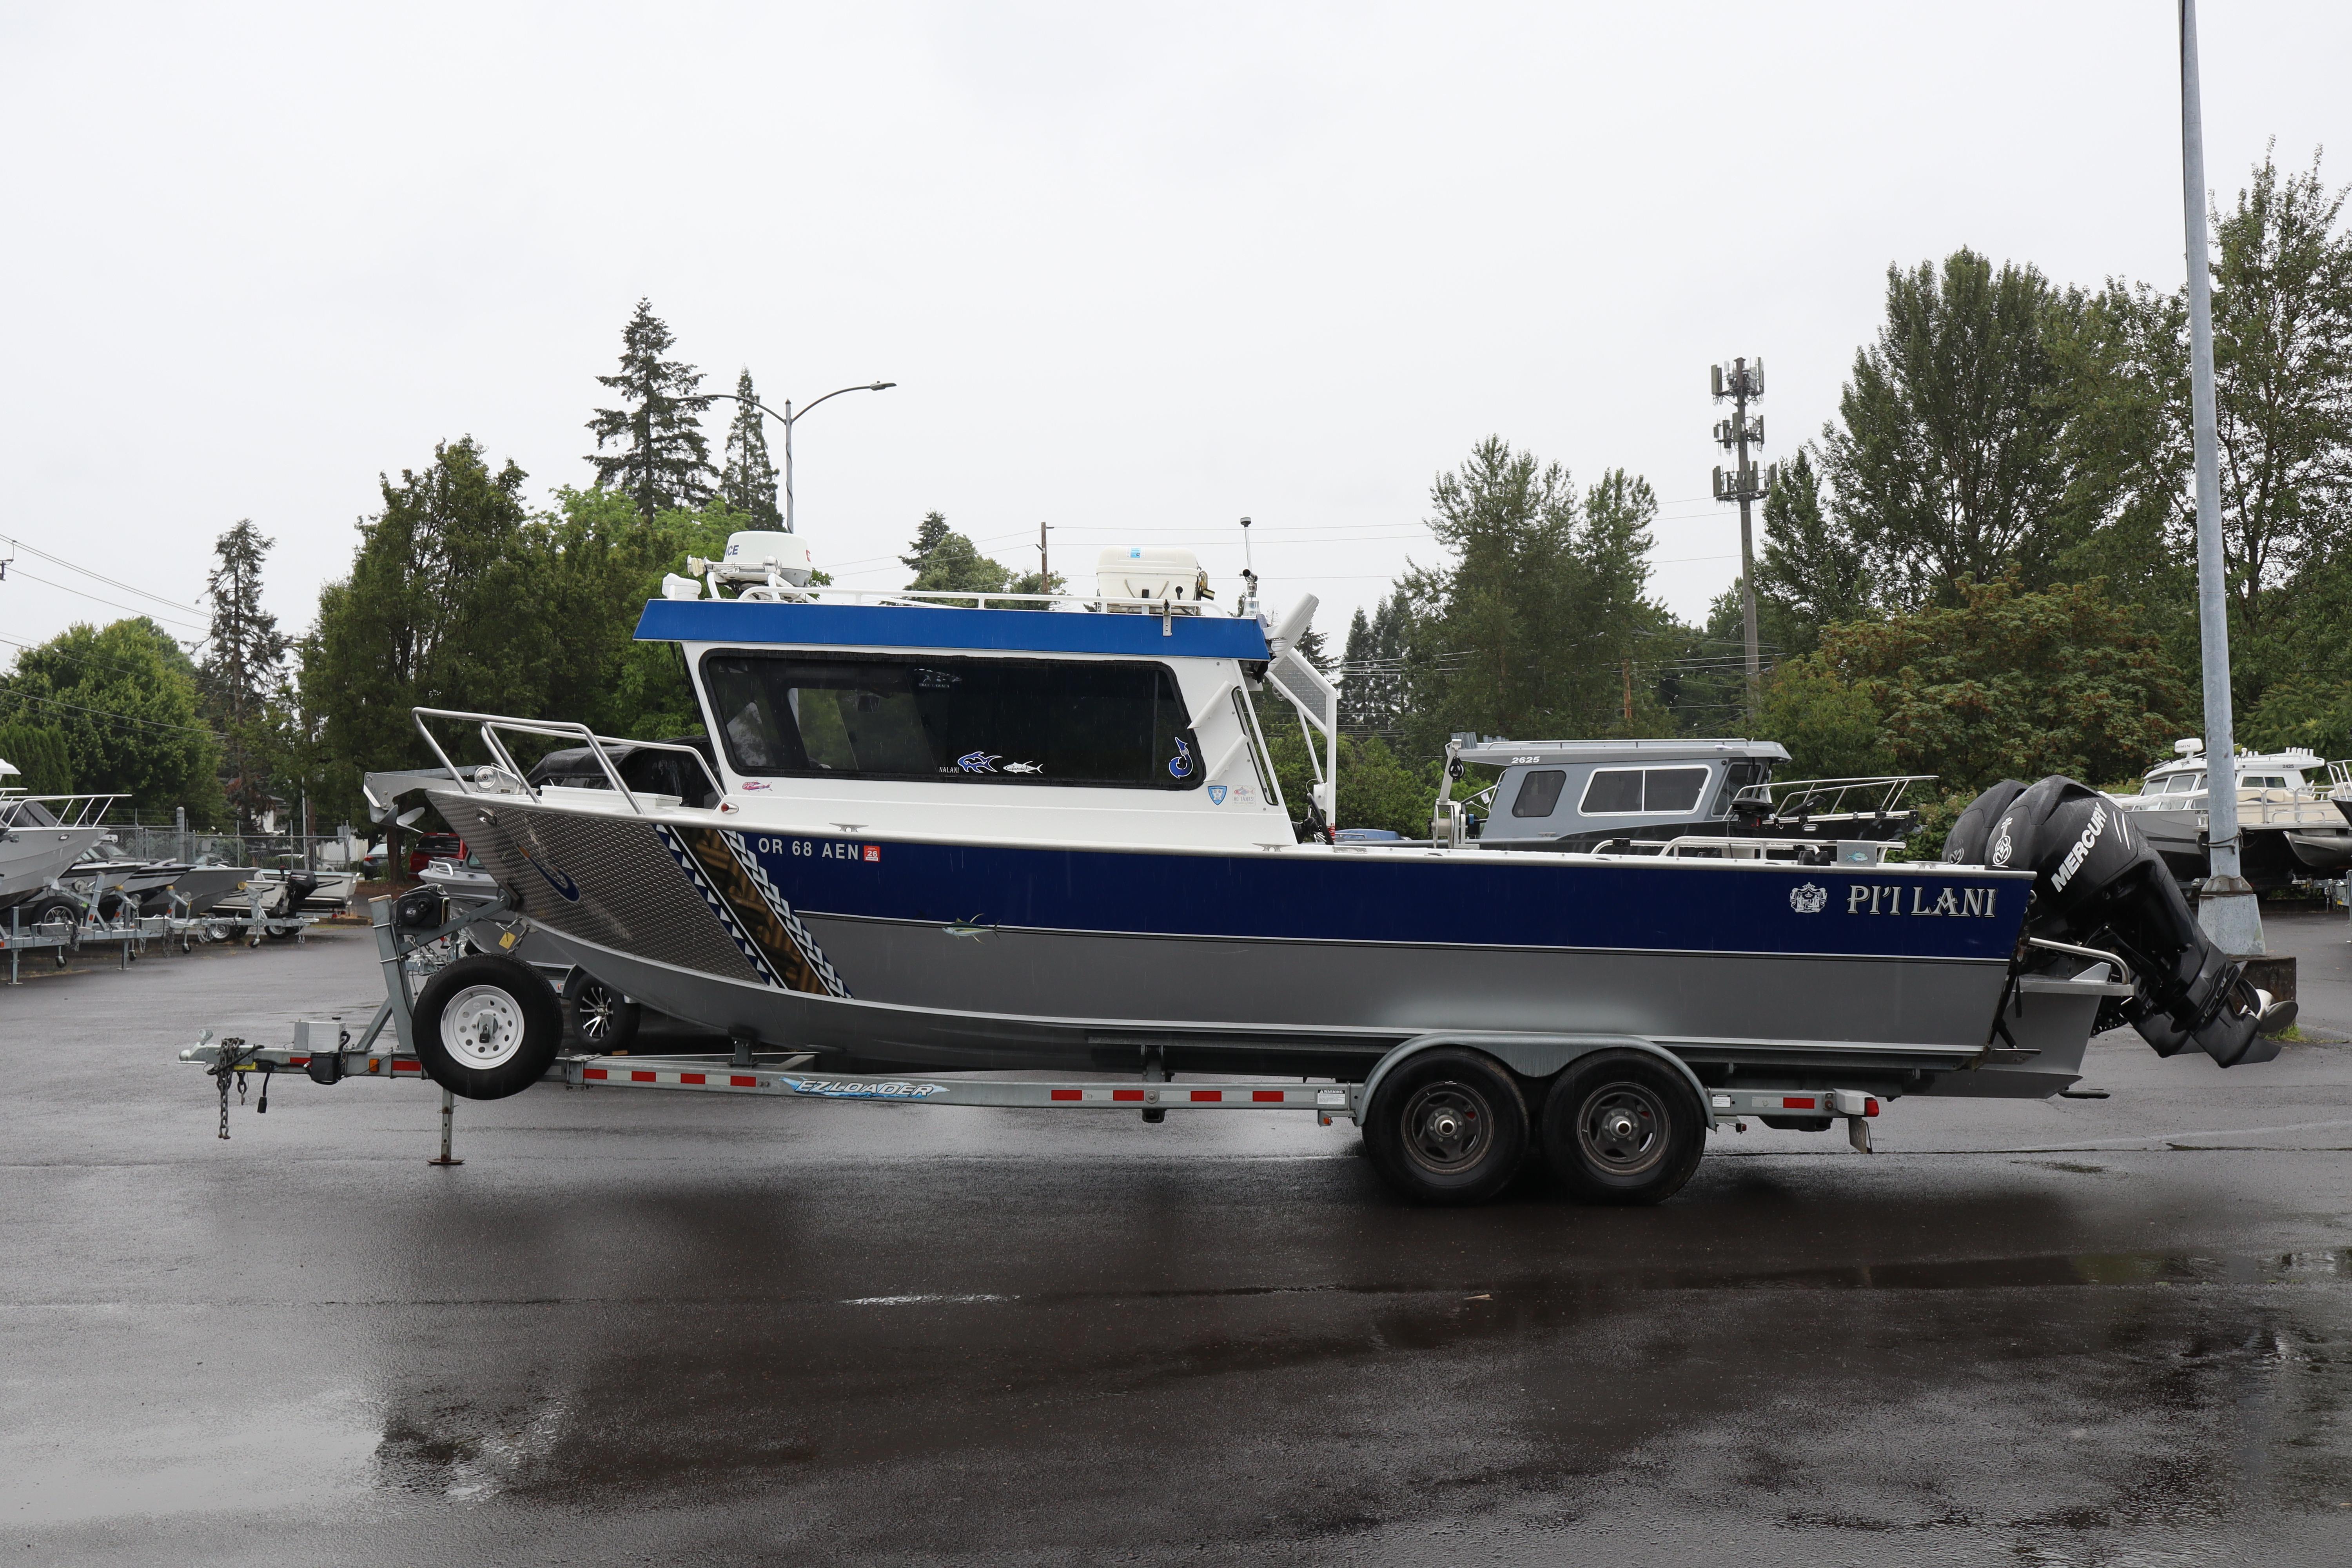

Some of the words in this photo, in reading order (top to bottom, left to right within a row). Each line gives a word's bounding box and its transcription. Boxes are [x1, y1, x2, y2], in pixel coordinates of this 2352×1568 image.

[1511, 756, 1540, 764] 2625
[758, 838, 783, 854] OR
[792, 840, 812, 857] 68
[822, 843, 858, 860] AEN
[2051, 802, 2107, 893] MERCURY
[1911, 887, 1998, 917] LANI
